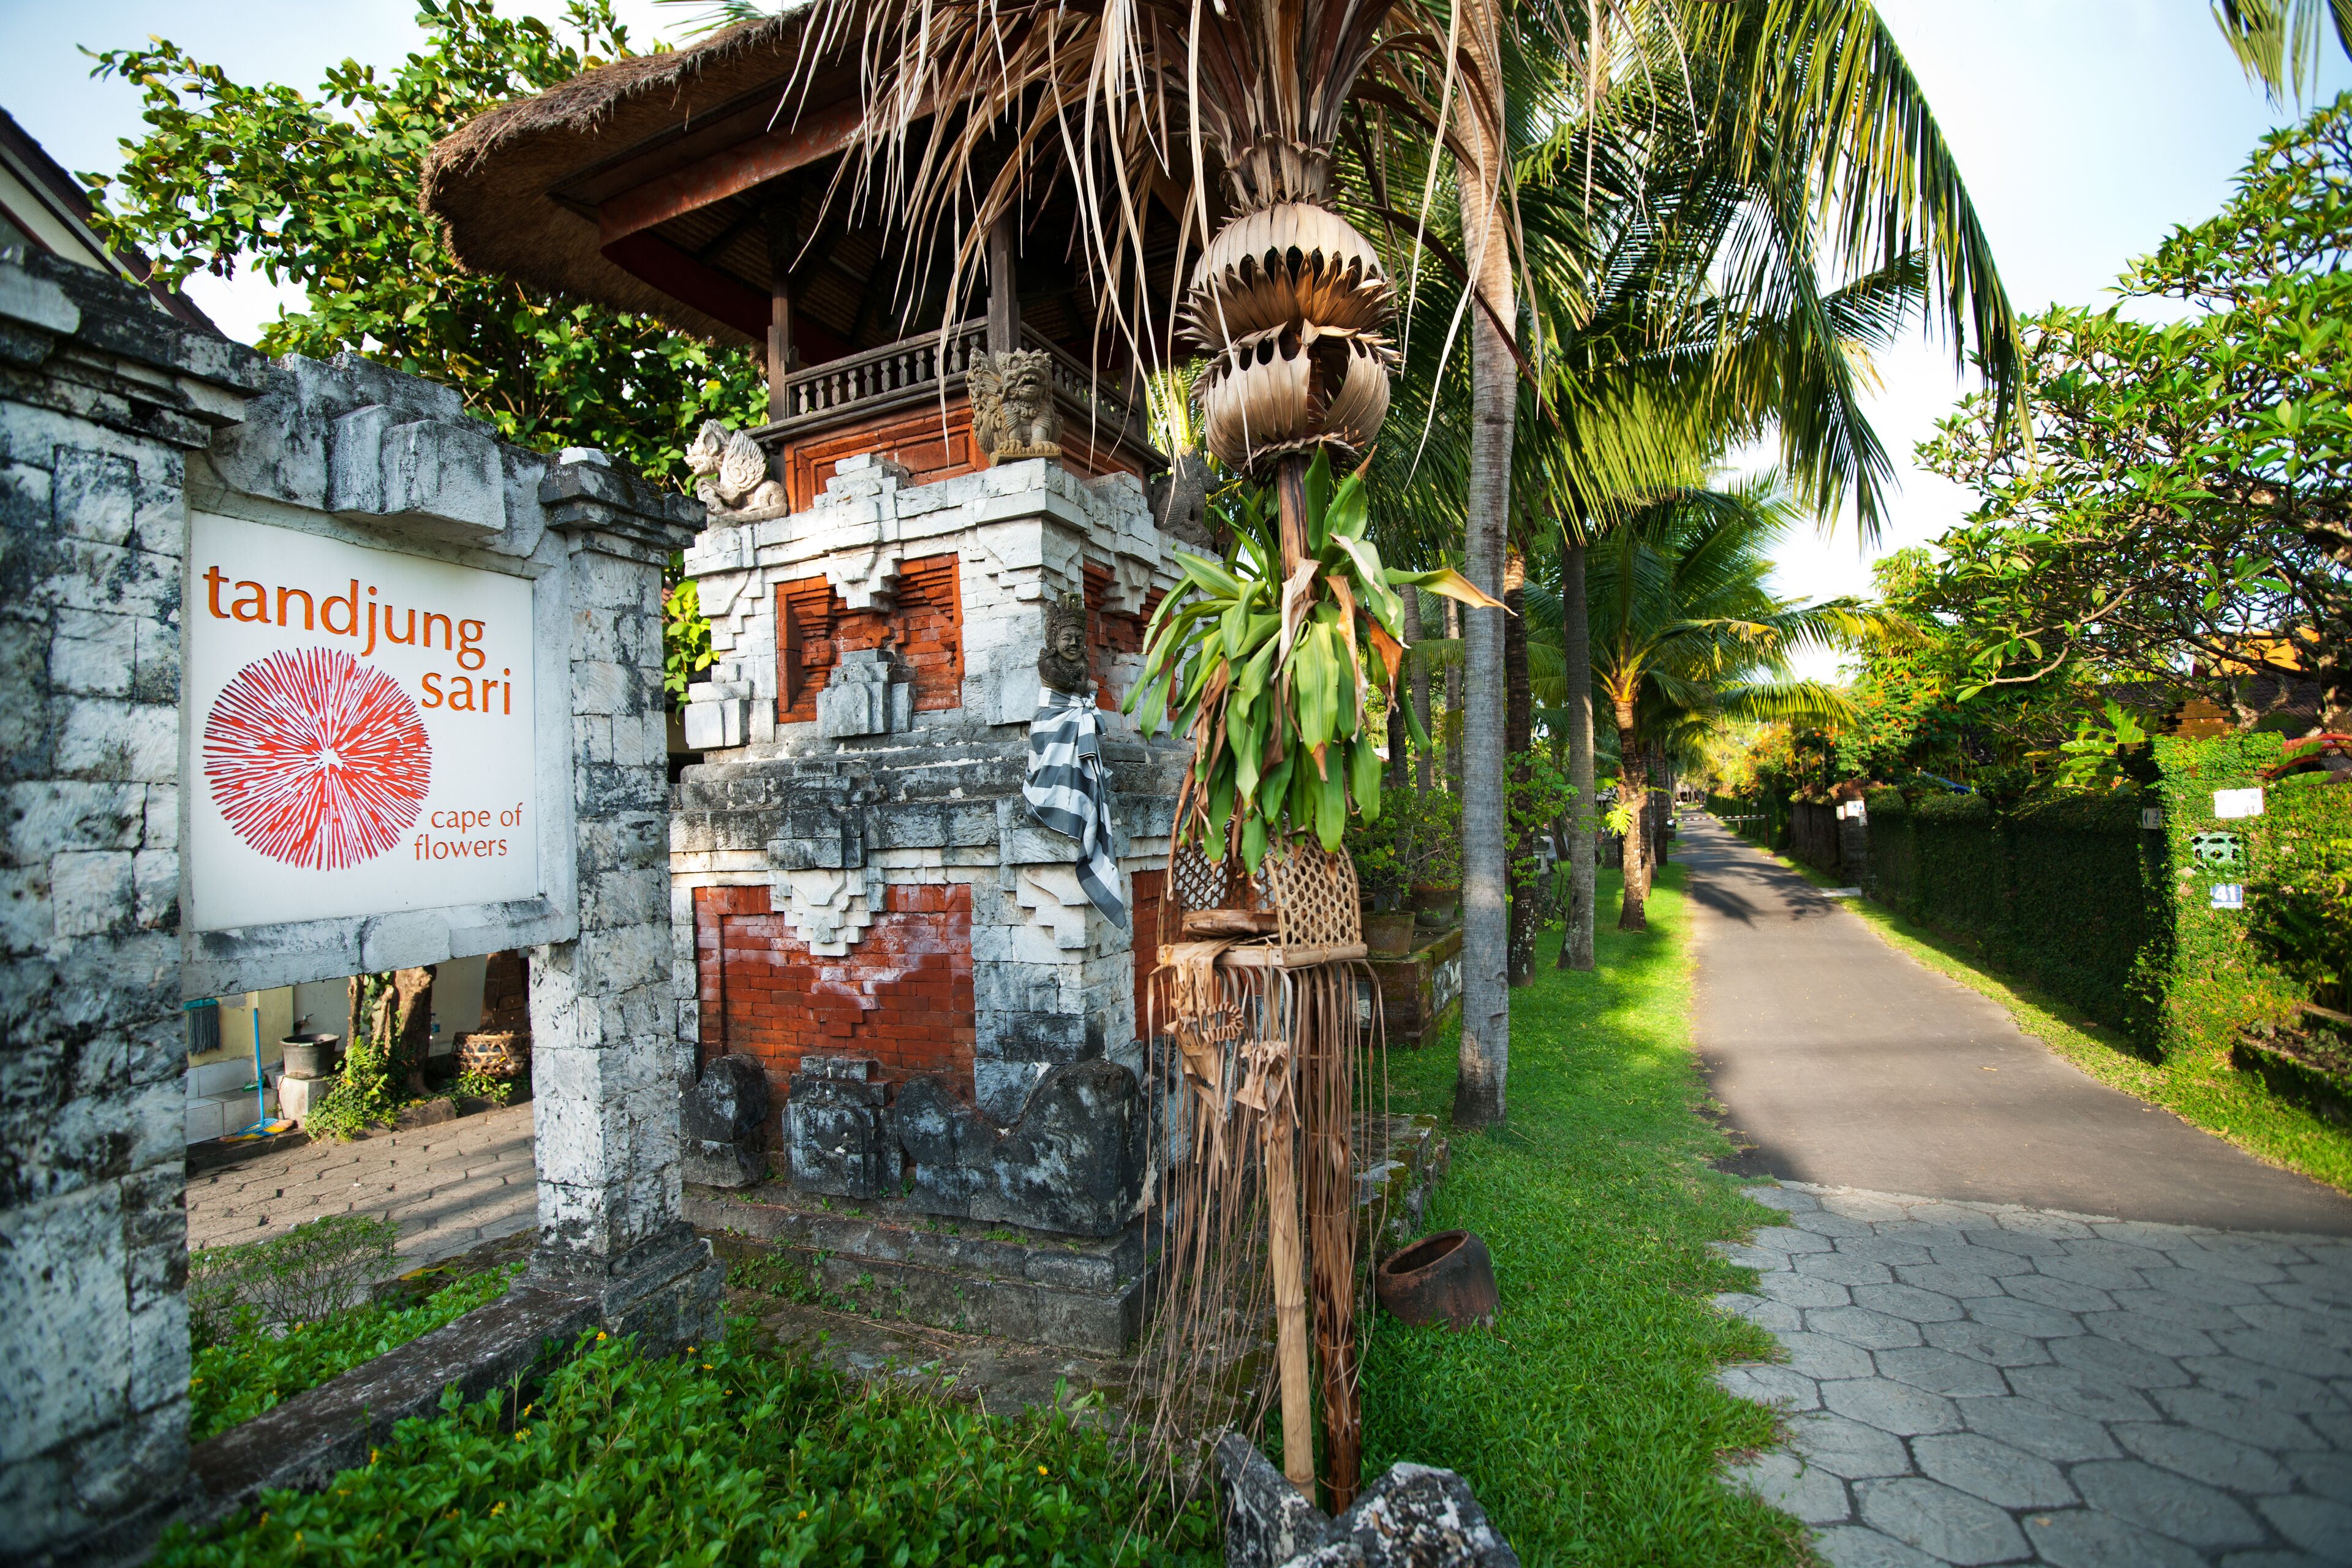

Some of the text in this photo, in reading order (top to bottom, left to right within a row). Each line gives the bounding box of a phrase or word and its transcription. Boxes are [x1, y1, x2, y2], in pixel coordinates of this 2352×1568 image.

[203, 566, 486, 671] tandjung
[421, 668, 511, 715] sari
[431, 802, 524, 834] cape of
[2244, 805, 2255, 815] 41
[414, 834, 508, 861] flowers
[2214, 885, 2236, 902] 41
